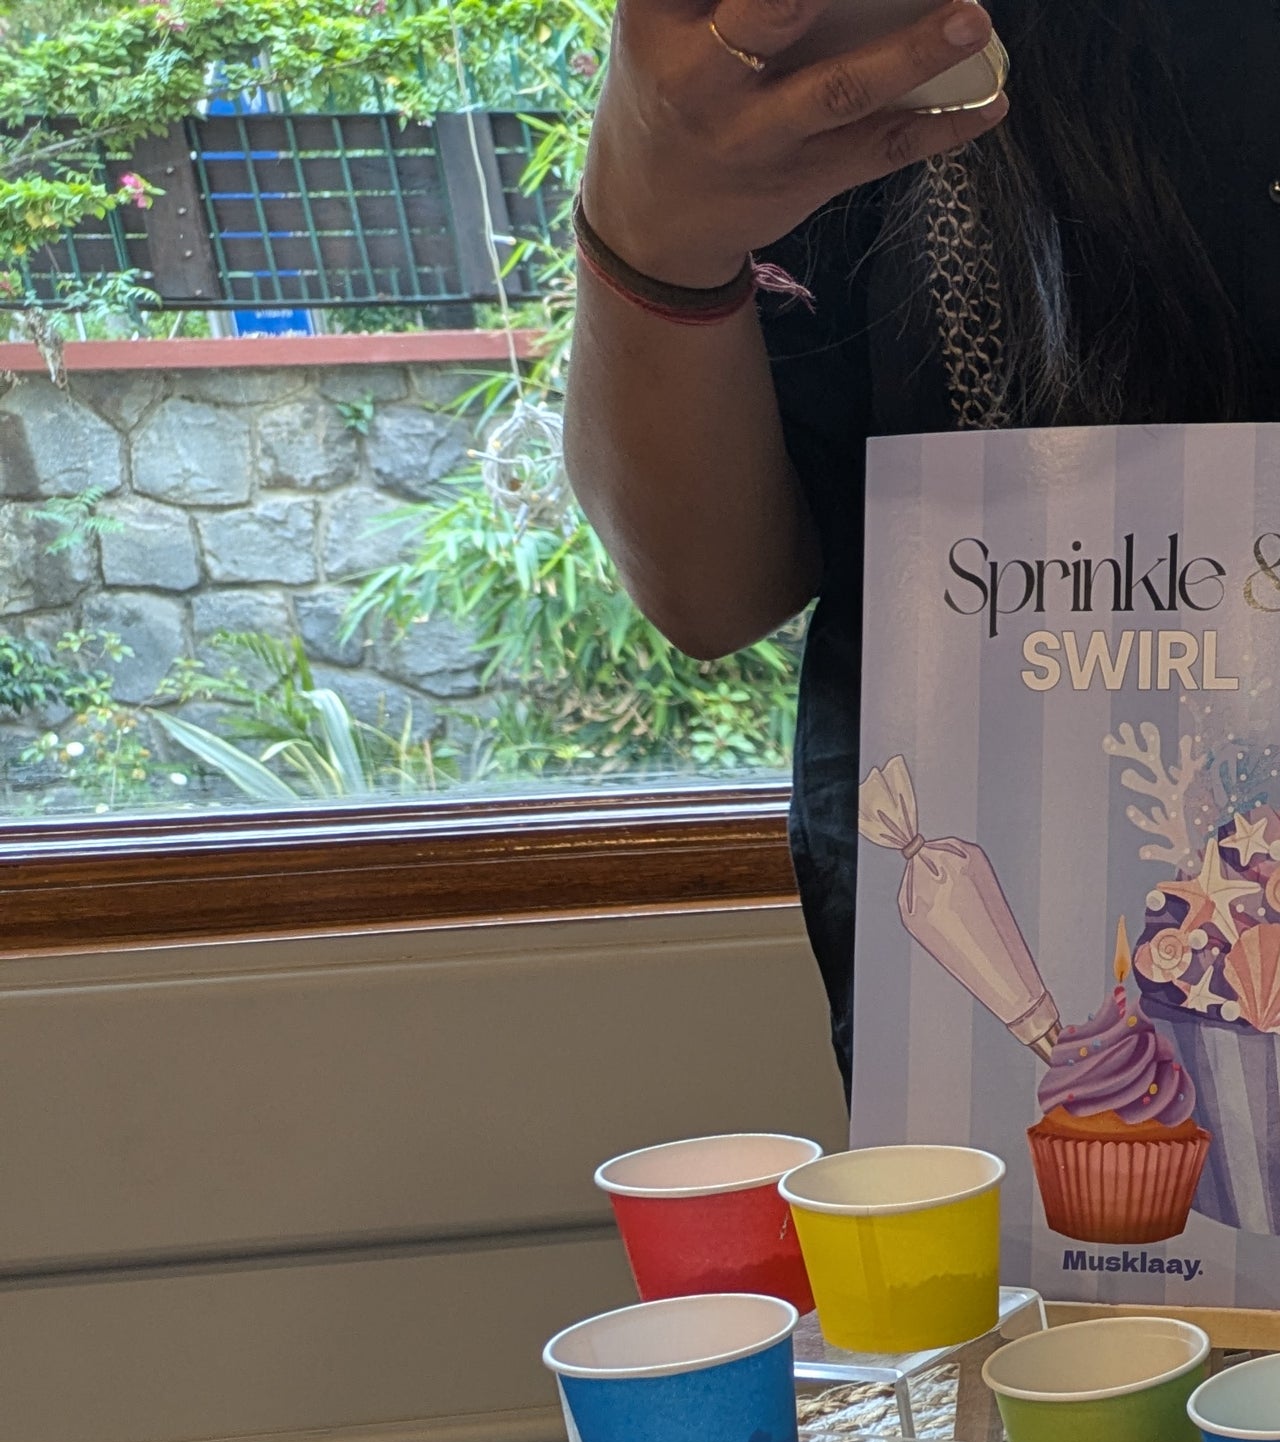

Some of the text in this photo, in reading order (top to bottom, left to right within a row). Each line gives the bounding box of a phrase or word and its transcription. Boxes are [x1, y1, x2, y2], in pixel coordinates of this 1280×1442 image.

[944, 532, 1227, 638] Sprinkle
[1021, 629, 1240, 692] SWIRL
[1062, 1250, 1204, 1281] Musklaay.
